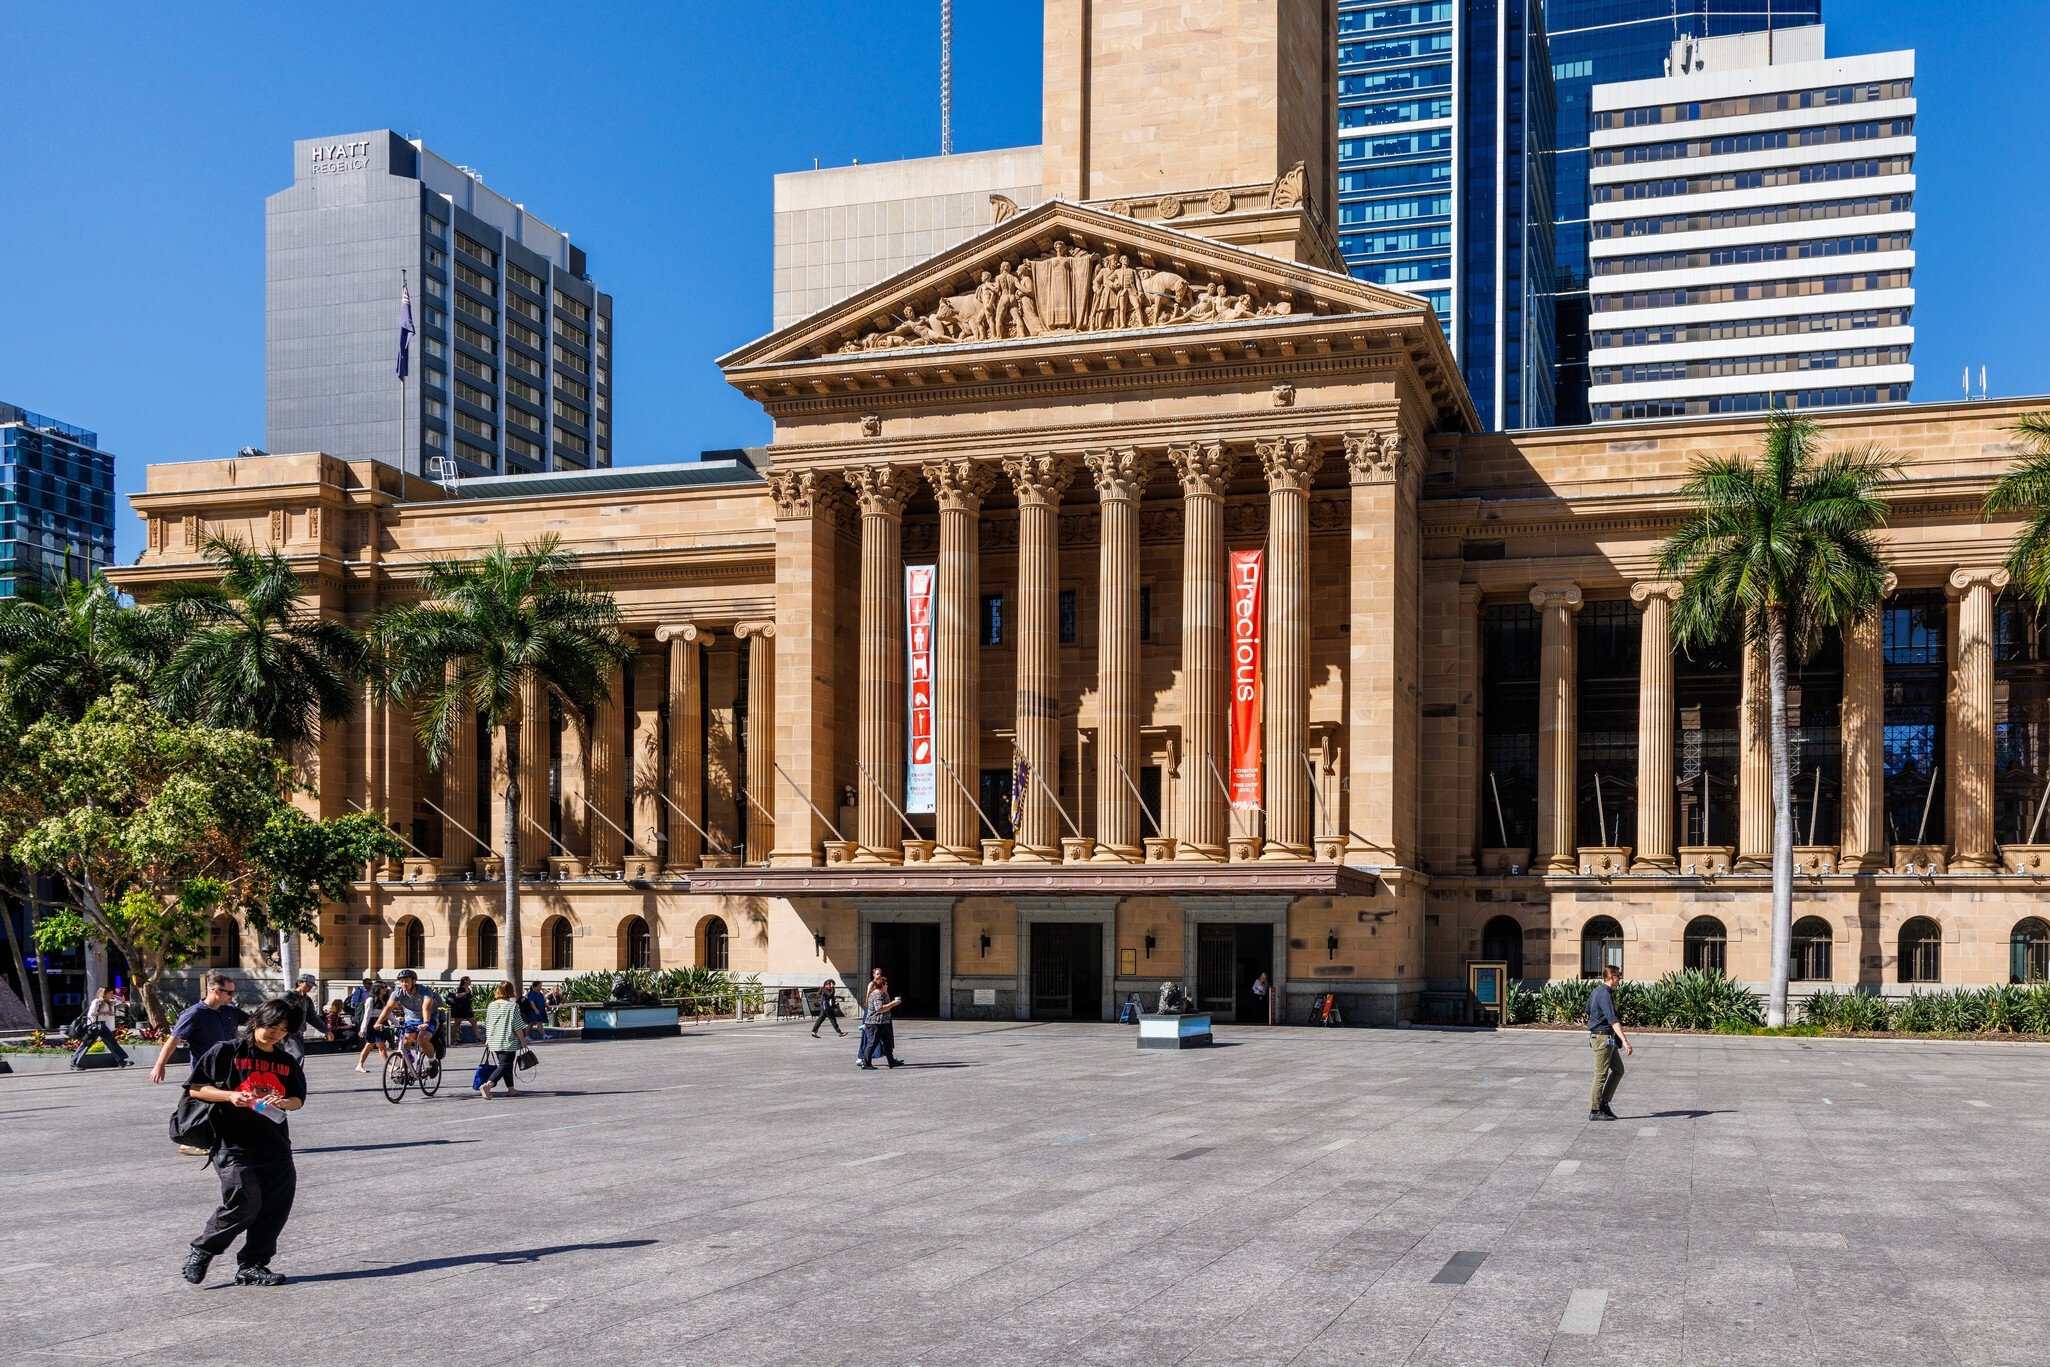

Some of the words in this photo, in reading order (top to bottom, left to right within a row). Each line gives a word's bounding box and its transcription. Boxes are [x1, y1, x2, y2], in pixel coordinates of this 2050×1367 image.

[312, 141, 369, 162] HYATT
[312, 159, 369, 175] REGENCY
[1236, 563, 1260, 702] Precious
